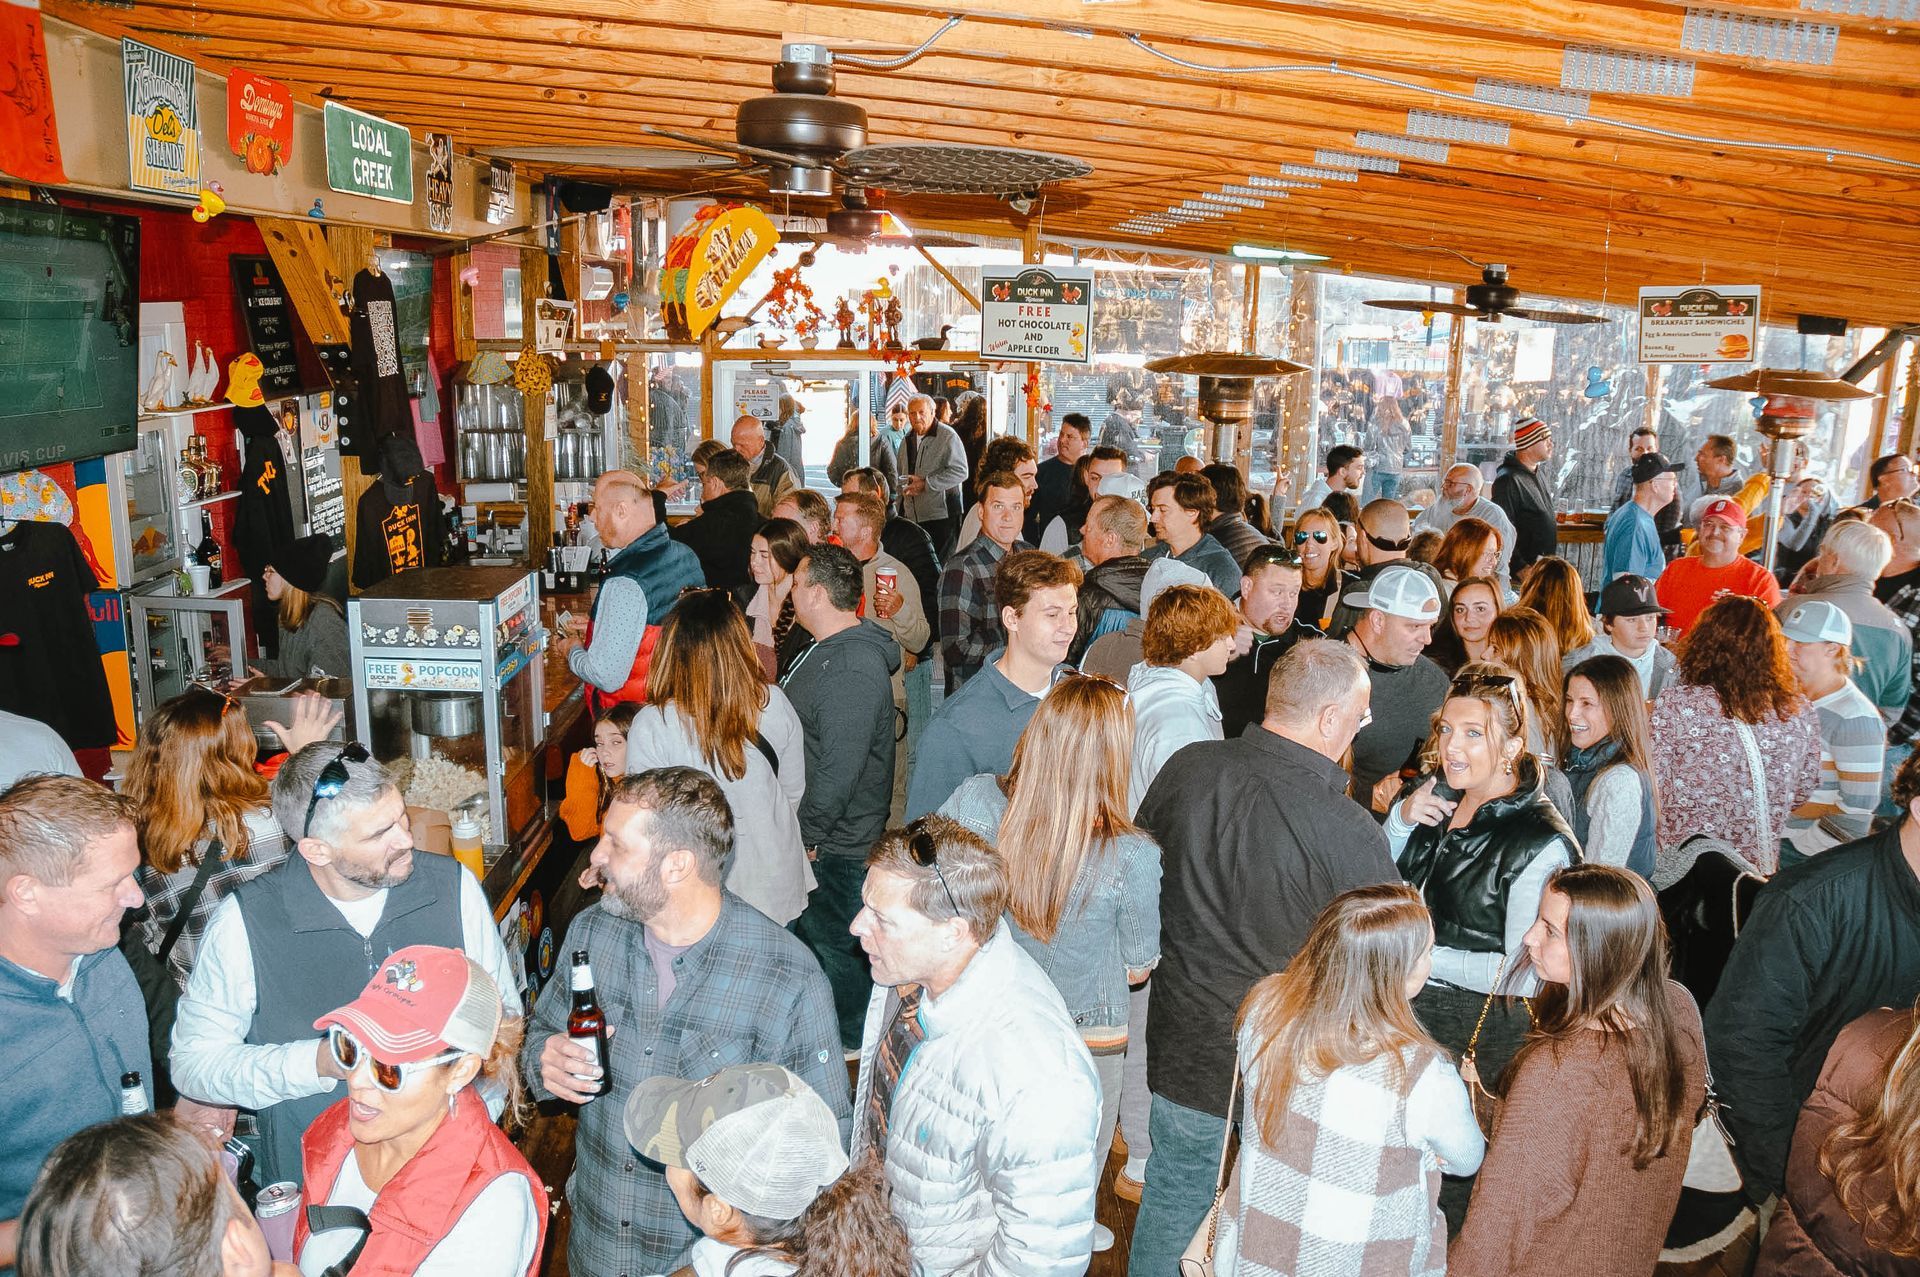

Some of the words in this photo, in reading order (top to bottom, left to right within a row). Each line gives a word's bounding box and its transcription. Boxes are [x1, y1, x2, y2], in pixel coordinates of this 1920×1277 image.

[240, 83, 284, 129] Dominga
[146, 137, 185, 172] SHANDY
[353, 156, 394, 191] CREEK
[490, 166, 510, 194] TRULY
[428, 177, 453, 206] HEAVY
[1017, 287, 1039, 297] DUCK
[1039, 288, 1054, 297] INN
[1018, 305, 1051, 317] FREE
[1679, 304, 1702, 312] DUCK
[1703, 304, 1719, 312] INN
[998, 318, 1017, 328] HOT
[1018, 319, 1071, 331] CHOCOLATE
[1024, 333, 1043, 342] AND
[1007, 344, 1033, 353] APPLE
[1034, 346, 1059, 355] CIDER
[36, 445, 66, 460] CUP
[388, 519, 406, 532] DUCK
[405, 513, 417, 524] INN
[368, 664, 398, 675] FREE
[419, 665, 480, 677] POPCORN
